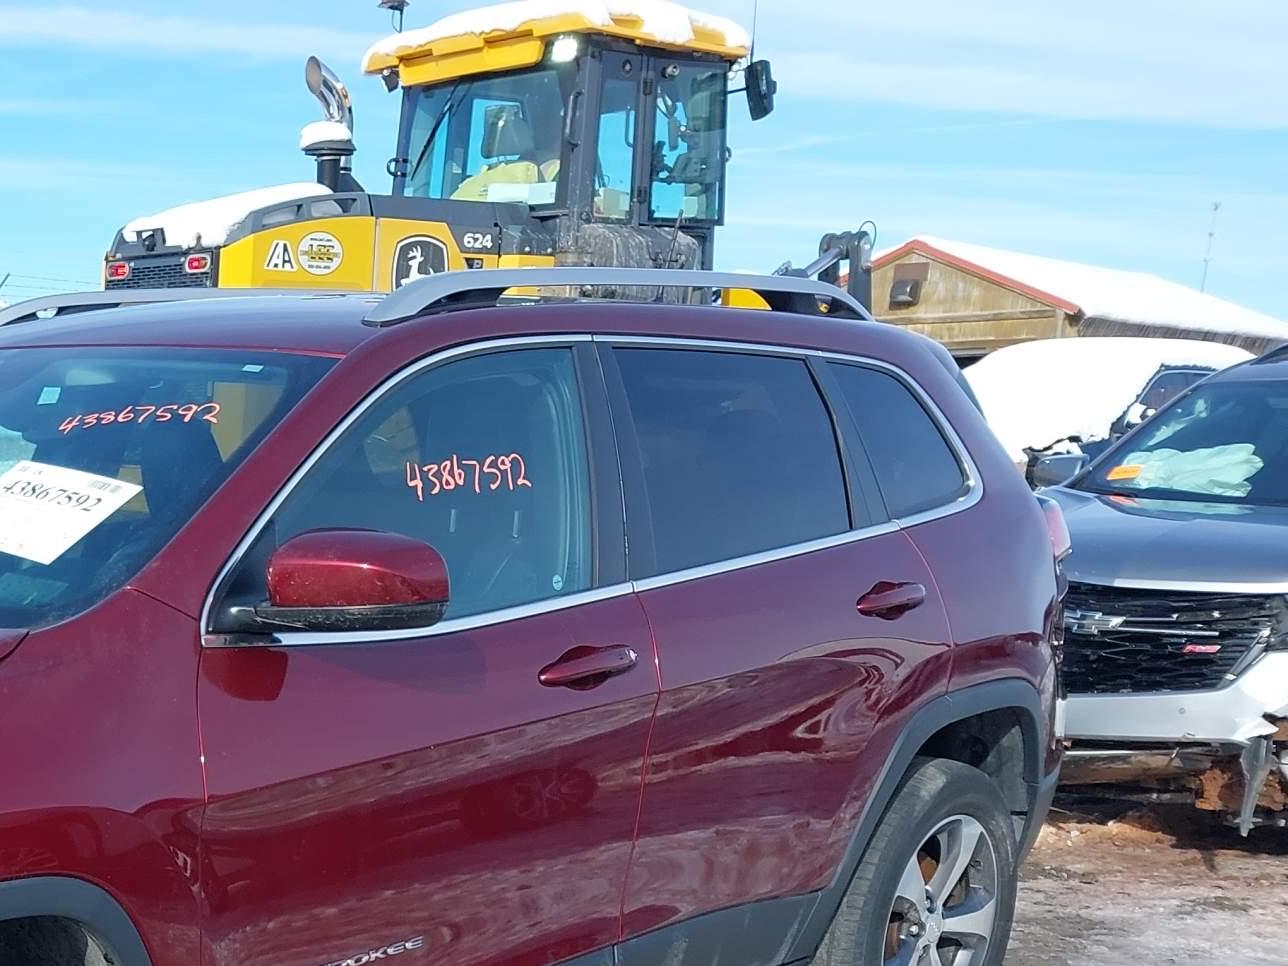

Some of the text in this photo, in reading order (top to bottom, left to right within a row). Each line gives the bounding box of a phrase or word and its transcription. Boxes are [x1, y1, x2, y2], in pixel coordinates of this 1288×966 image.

[463, 232, 493, 249] 624
[58, 402, 221, 435] 43867592
[405, 453, 532, 502] 43867592
[2, 479, 103, 512] 43867592
